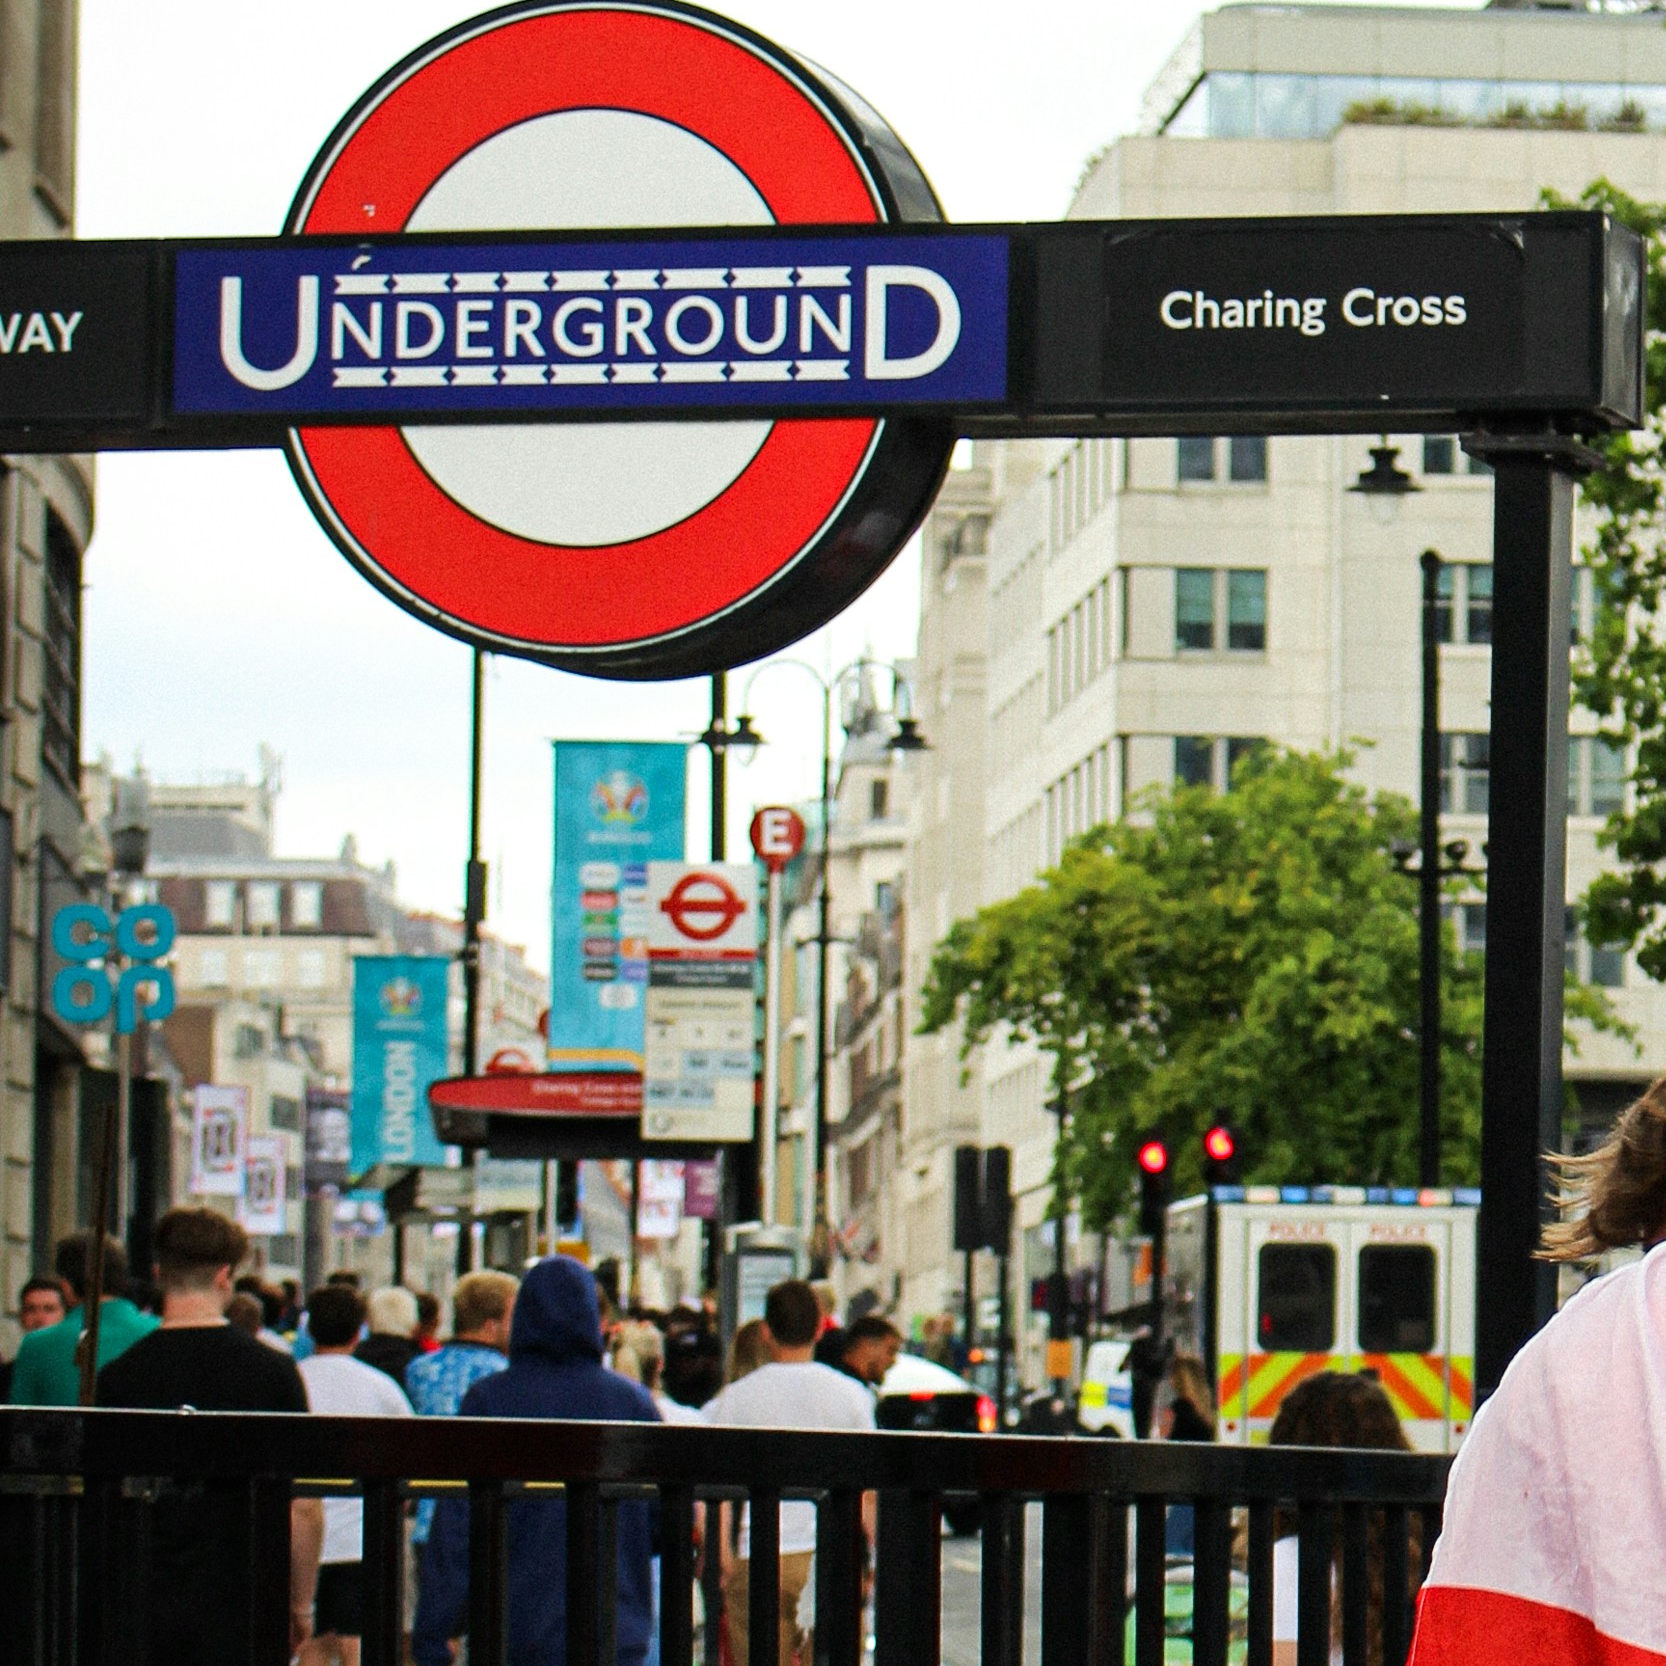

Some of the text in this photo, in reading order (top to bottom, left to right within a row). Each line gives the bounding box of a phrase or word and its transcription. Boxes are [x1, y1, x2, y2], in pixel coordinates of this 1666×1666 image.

[221, 264, 962, 392] UNDERGROUND
[1160, 287, 1467, 336] Charing Cross
[760, 808, 793, 854] E
